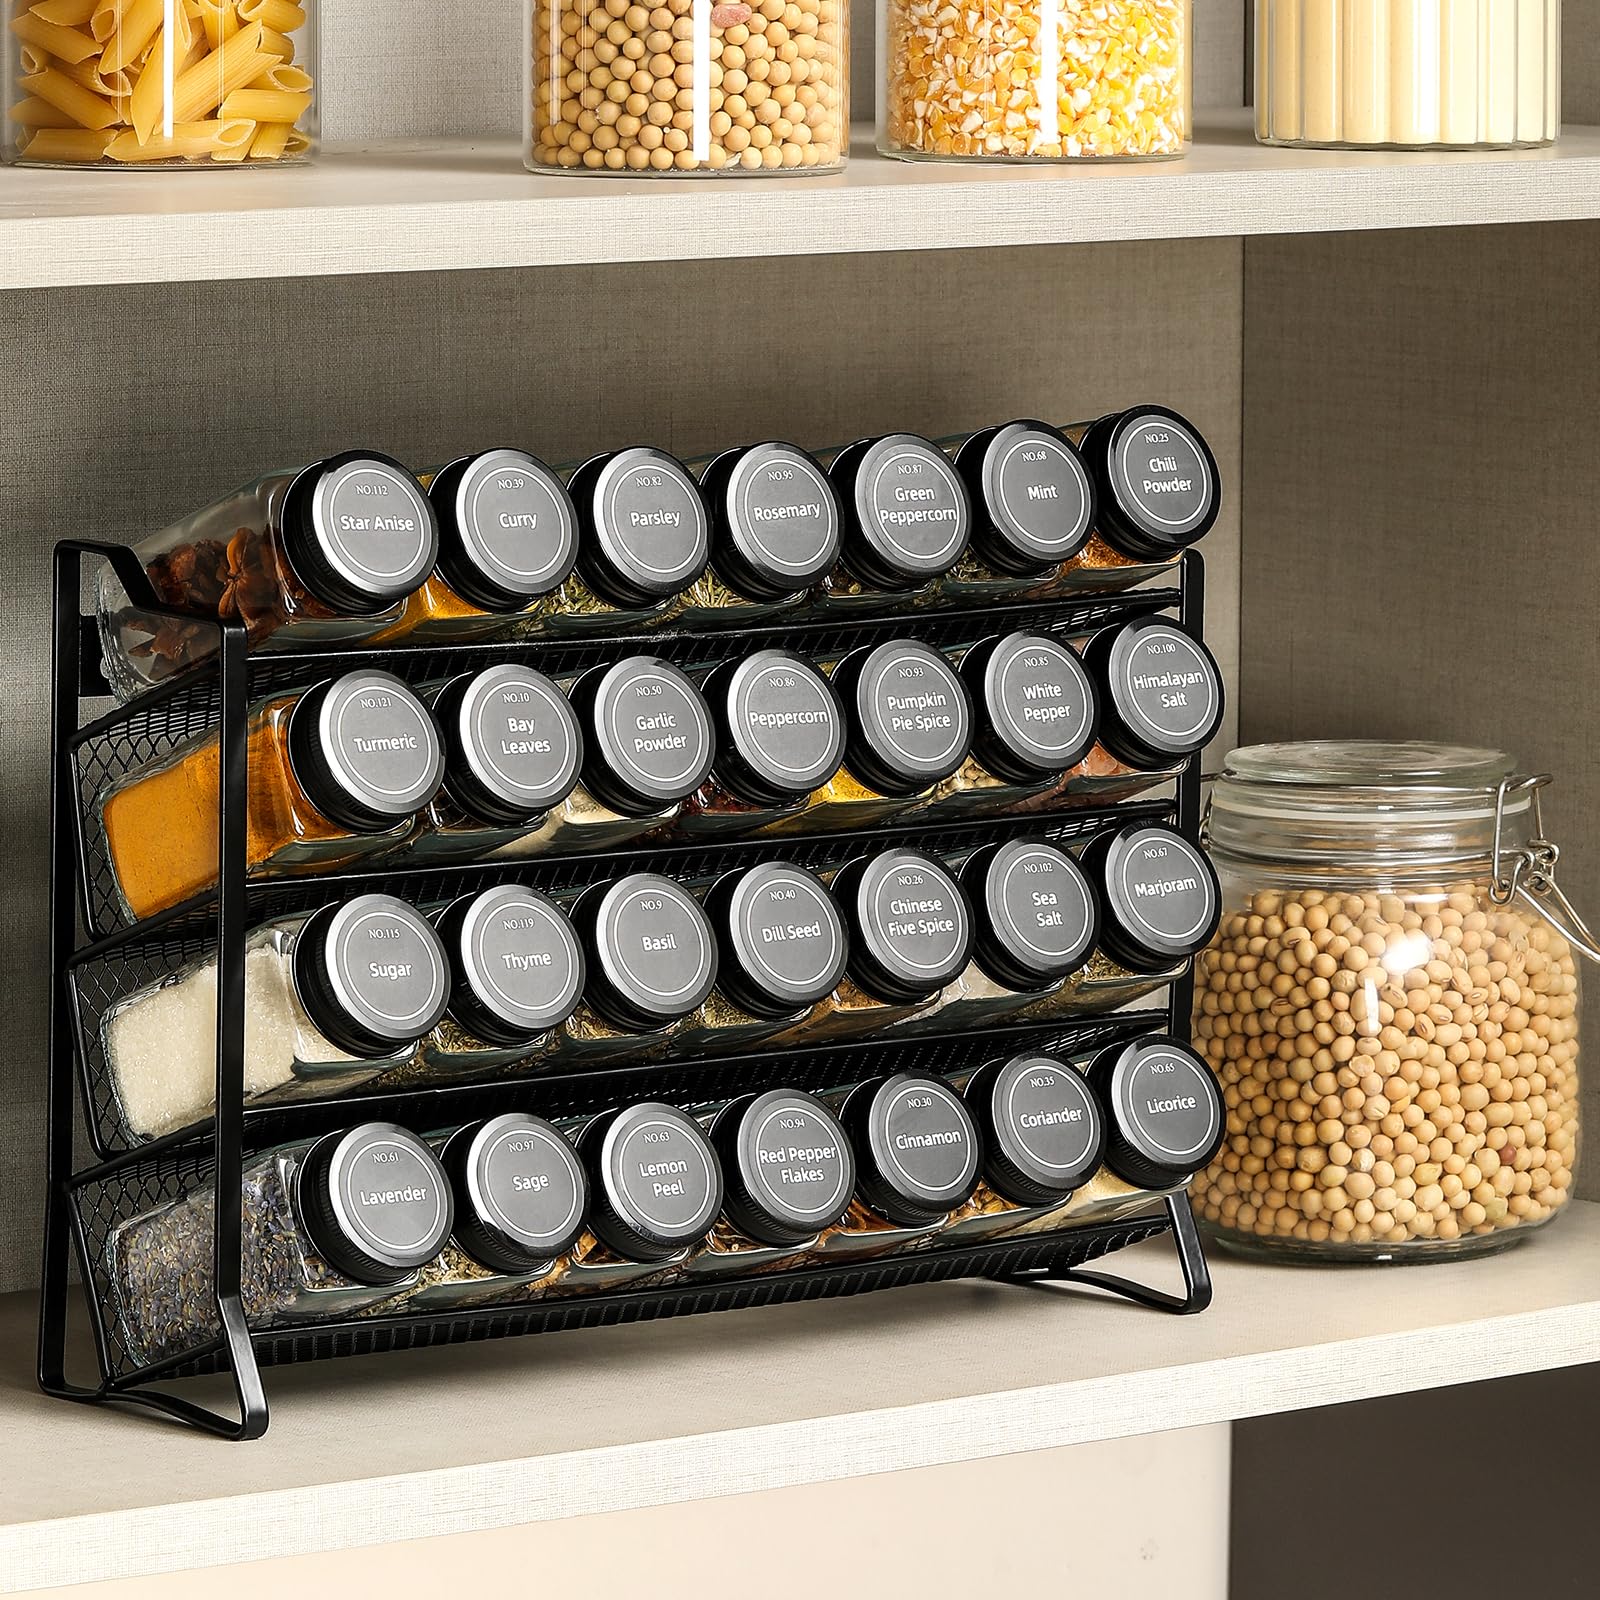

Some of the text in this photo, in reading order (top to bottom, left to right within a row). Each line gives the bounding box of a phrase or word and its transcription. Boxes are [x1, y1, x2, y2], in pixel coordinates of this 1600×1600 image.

[1144, 433, 1169, 444] NO.25
[1021, 450, 1047, 462] NO.68
[1149, 456, 1177, 473] Chili
[767, 471, 793, 481] NO.95
[897, 464, 922, 475] NO.87
[355, 485, 388, 495] NO.112
[497, 478, 524, 489] NO.39
[635, 476, 662, 487] NO.82
[1142, 476, 1192, 494] Powder
[894, 487, 935, 502] Green
[1027, 484, 1058, 501] Mint
[499, 513, 537, 529] Curry
[630, 509, 680, 527] Parsley
[753, 503, 820, 522] Rosemary
[880, 508, 957, 525] Peppercorn
[340, 515, 415, 531] Star Anise
[1146, 643, 1176, 655] NO.100
[1023, 656, 1049, 668] NO.85
[898, 667, 924, 678] NO.93
[1133, 671, 1204, 690] Himalayan
[768, 677, 795, 687] NO.86
[502, 692, 530, 703] NO.10
[635, 685, 662, 697] NO.50
[1022, 683, 1062, 700] White
[1160, 691, 1188, 708] Salt
[359, 697, 392, 709] NO.121
[887, 691, 947, 711] Pumpkin
[636, 712, 677, 731] Garlic
[749, 709, 828, 729] Peppercorn
[891, 713, 951, 732] Pie Spice
[1023, 705, 1071, 724] Pepper
[507, 717, 535, 735] Bay
[353, 733, 418, 752] Turmeric
[501, 739, 551, 755] Leaves
[634, 733, 687, 753] Powder
[1143, 847, 1168, 860] NO.67
[1023, 863, 1053, 874] NO.102
[897, 874, 924, 886] NO.26
[1134, 877, 1197, 898] Marjoram
[769, 889, 796, 901] NO.40
[1031, 891, 1058, 906] Sea
[640, 899, 662, 911] NO.9
[890, 898, 943, 916] Chinese
[502, 917, 534, 930] NO.119
[887, 917, 954, 937] Five Spice
[1036, 910, 1064, 929] Salt
[368, 928, 400, 939] NO.115
[761, 921, 822, 943] Dill Seed
[642, 933, 677, 951] Basil
[502, 953, 552, 971] Thyme
[369, 962, 412, 980] Sugar
[1149, 1062, 1175, 1075] NO.65
[1030, 1076, 1055, 1088] NO.35
[906, 1097, 932, 1109] NO.30
[1146, 1095, 1197, 1114] Licorice
[779, 1118, 805, 1129] NO.94
[1020, 1107, 1082, 1128] Coriander
[643, 1131, 670, 1144] NO.63
[895, 1130, 962, 1150] Cinnamon
[507, 1140, 534, 1153] NO.97
[759, 1146, 836, 1164] Red Pepper
[372, 1151, 399, 1164] NO.61
[639, 1160, 688, 1177] Lemon
[780, 1167, 825, 1184] Flakes
[512, 1173, 549, 1192] Sage
[652, 1179, 685, 1199] Peel
[360, 1185, 427, 1206] Lavender
